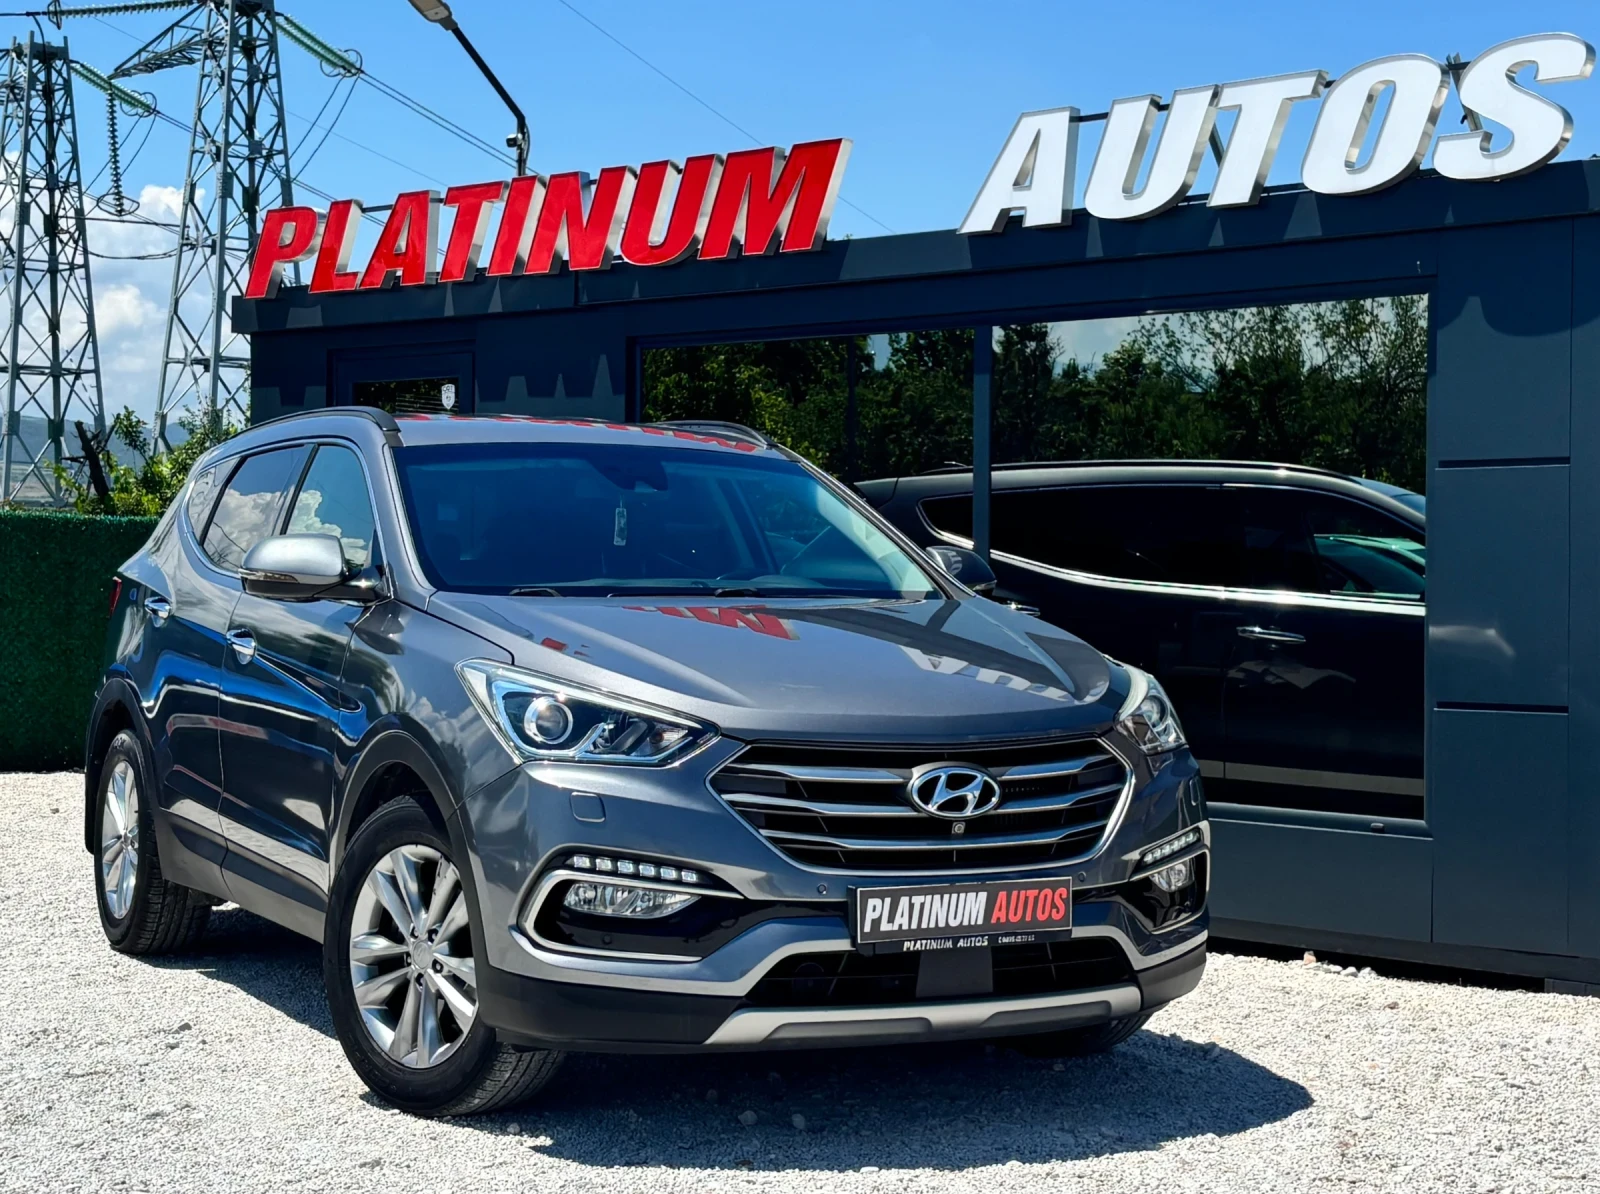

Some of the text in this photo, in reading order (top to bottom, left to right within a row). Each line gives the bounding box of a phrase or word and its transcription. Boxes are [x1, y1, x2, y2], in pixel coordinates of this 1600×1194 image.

[244, 32, 1596, 300] PLATINUM AUTOS
[863, 887, 1068, 933] PLATINUM AUTOS
[903, 938, 953, 952] PLATINUM
[956, 935, 989, 948] AUTOS
